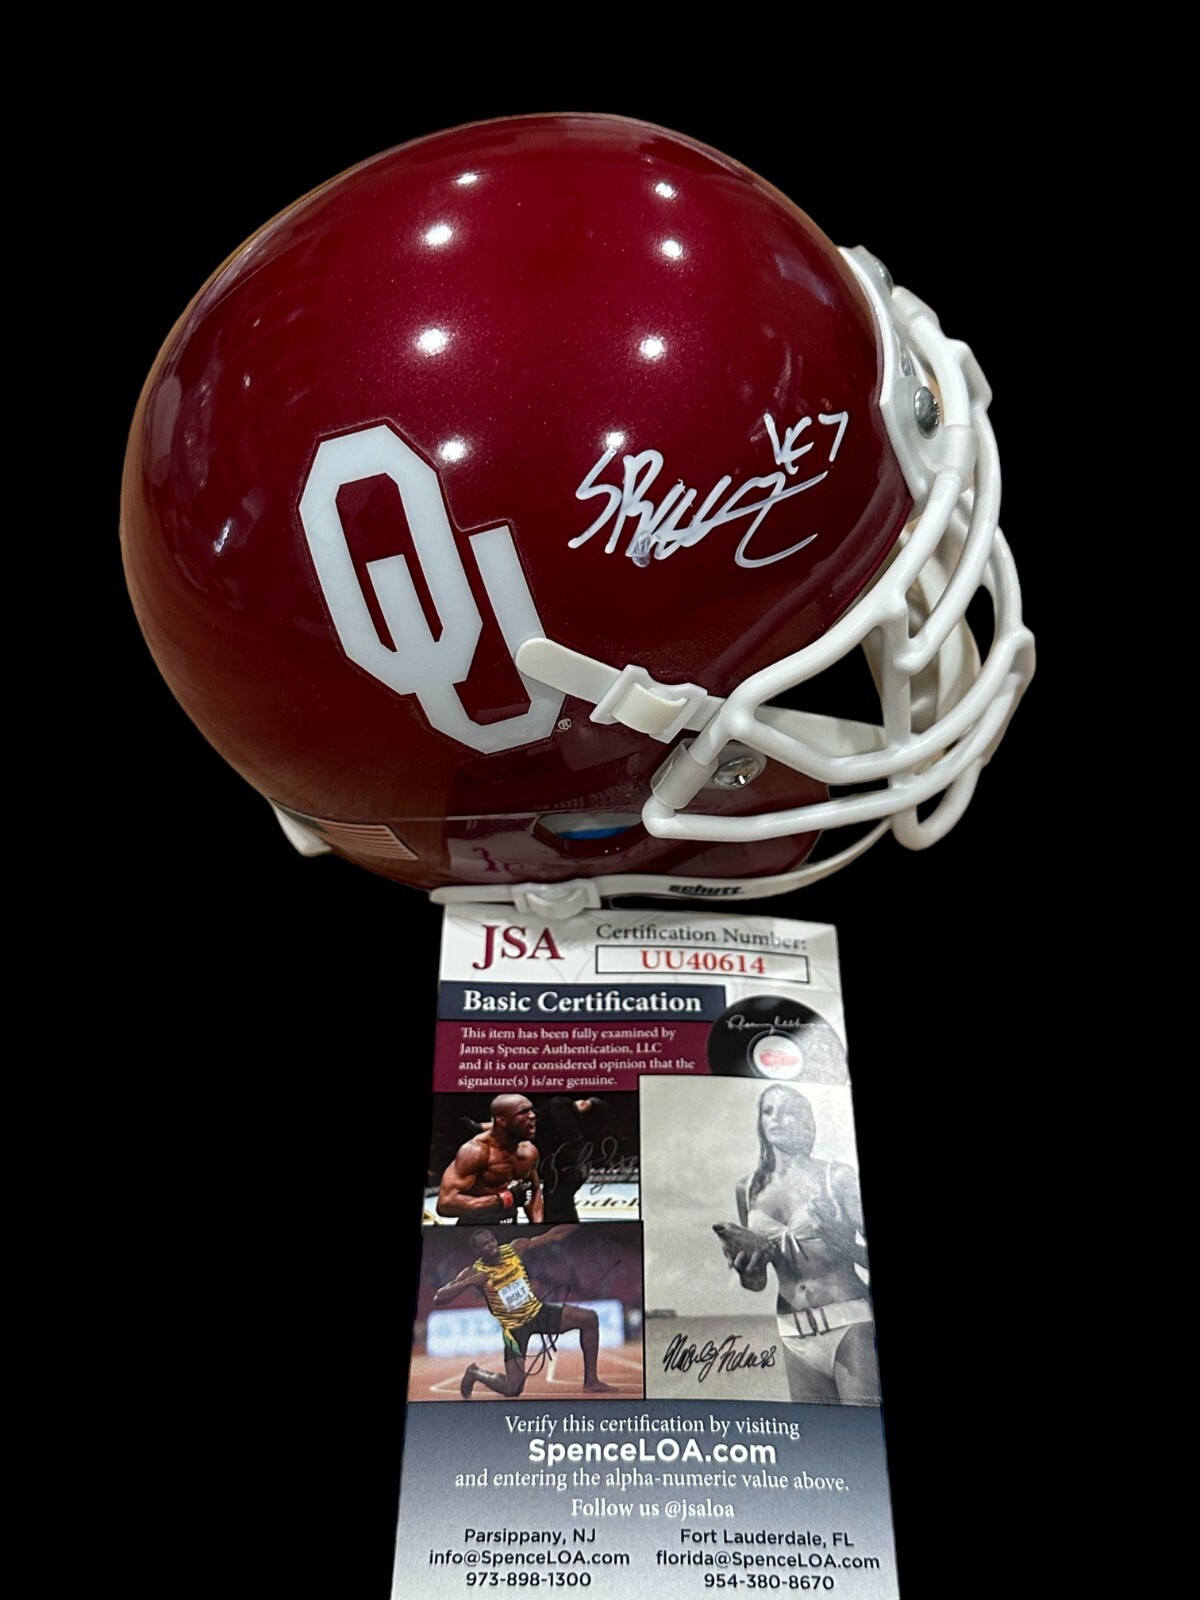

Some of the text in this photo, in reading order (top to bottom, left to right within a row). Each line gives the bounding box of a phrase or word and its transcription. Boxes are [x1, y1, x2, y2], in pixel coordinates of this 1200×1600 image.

[668, 884, 742, 896] schutt
[596, 924, 807, 950] Certification Number:
[472, 925, 564, 970] JSA
[641, 950, 766, 974] UU40614
[463, 990, 702, 1013] Basic Certification
[461, 1027, 676, 1041] This item has been fully examined by
[460, 1043, 662, 1057] James Spence Authentication, LLC
[459, 1059, 481, 1070] and
[485, 1060, 493, 1069] it
[496, 1060, 506, 1069] is
[532, 1059, 597, 1069] considered
[600, 1059, 646, 1073] opinion
[650, 1059, 672, 1068] that
[676, 1059, 695, 1069] the
[458, 1075, 617, 1088] signature(s) is/are genuine.
[505, 1414, 800, 1438] Verify this certification by visiting
[528, 1438, 777, 1466] SpenceLOA.com
[455, 1470, 849, 1493] and entering the alpha-numeric value above.
[571, 1499, 735, 1522] Follow us @jsaloa
[464, 1529, 596, 1547] Parsippany, NJ
[681, 1530, 854, 1548] Fort Lauderdale, FL
[429, 1550, 630, 1568] info@SpenceLOA.com
[656, 1551, 880, 1571] florida@SpenceLOA.com
[466, 1572, 591, 1587] 973-898-1300
[704, 1574, 835, 1590] 954-380-8670
